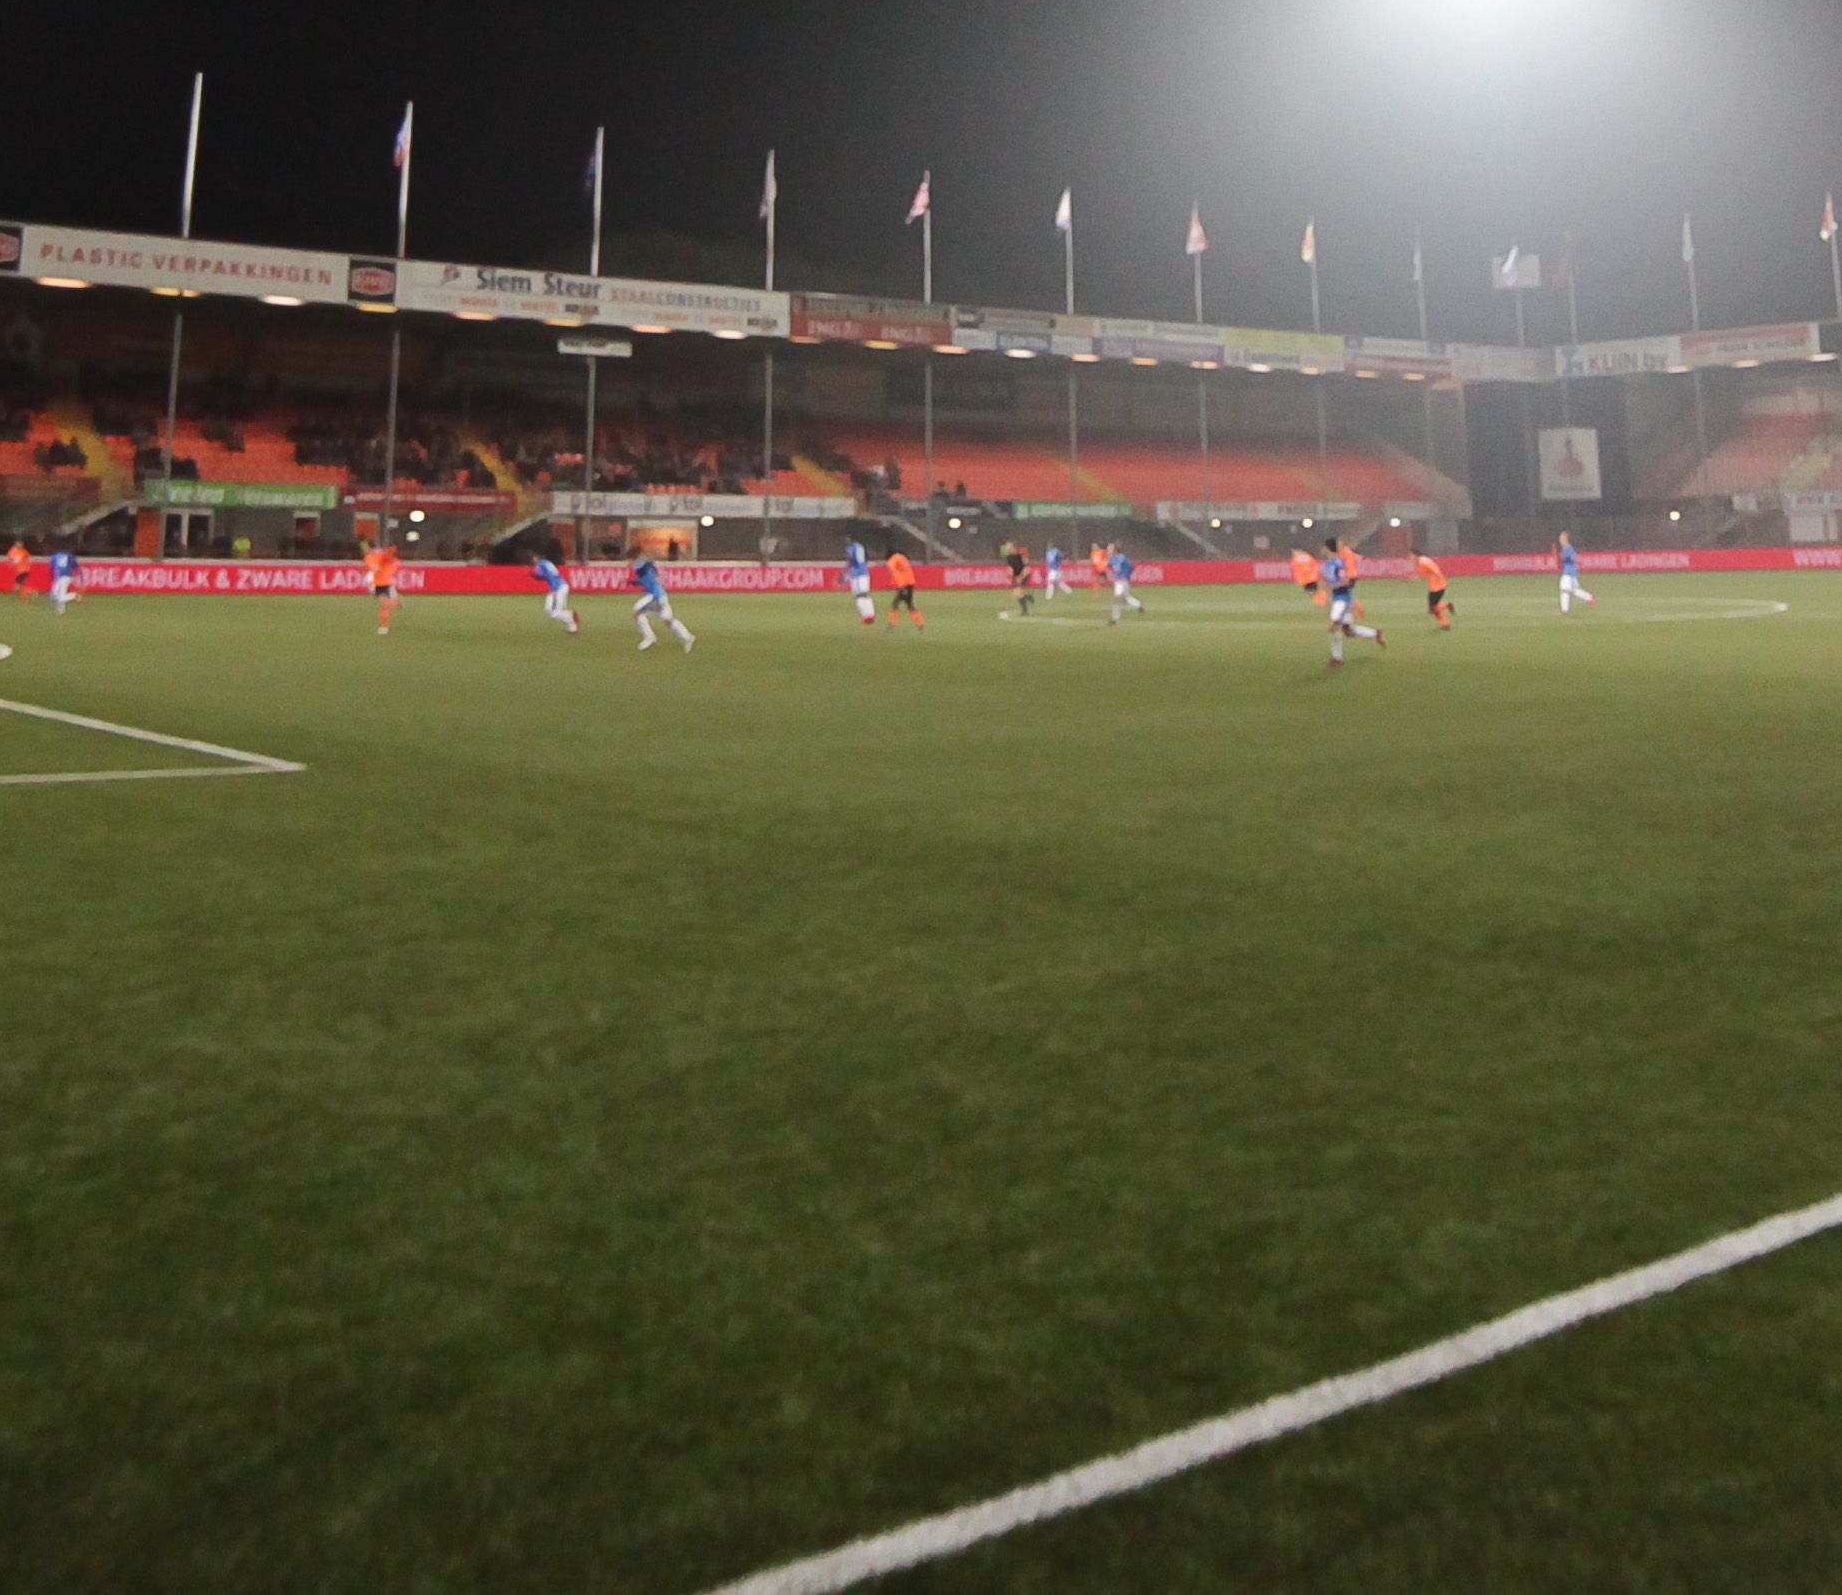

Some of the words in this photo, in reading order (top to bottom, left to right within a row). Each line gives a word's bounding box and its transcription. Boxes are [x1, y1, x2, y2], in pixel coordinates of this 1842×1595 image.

[40, 243, 143, 270] PLASTIC
[153, 253, 332, 286] VERPAKKINGEN
[476, 269, 532, 296] Siem
[543, 273, 602, 300] Steur
[75, 567, 210, 589] BREAKBULK
[215, 568, 230, 589] &
[236, 568, 312, 590] ZWARE
